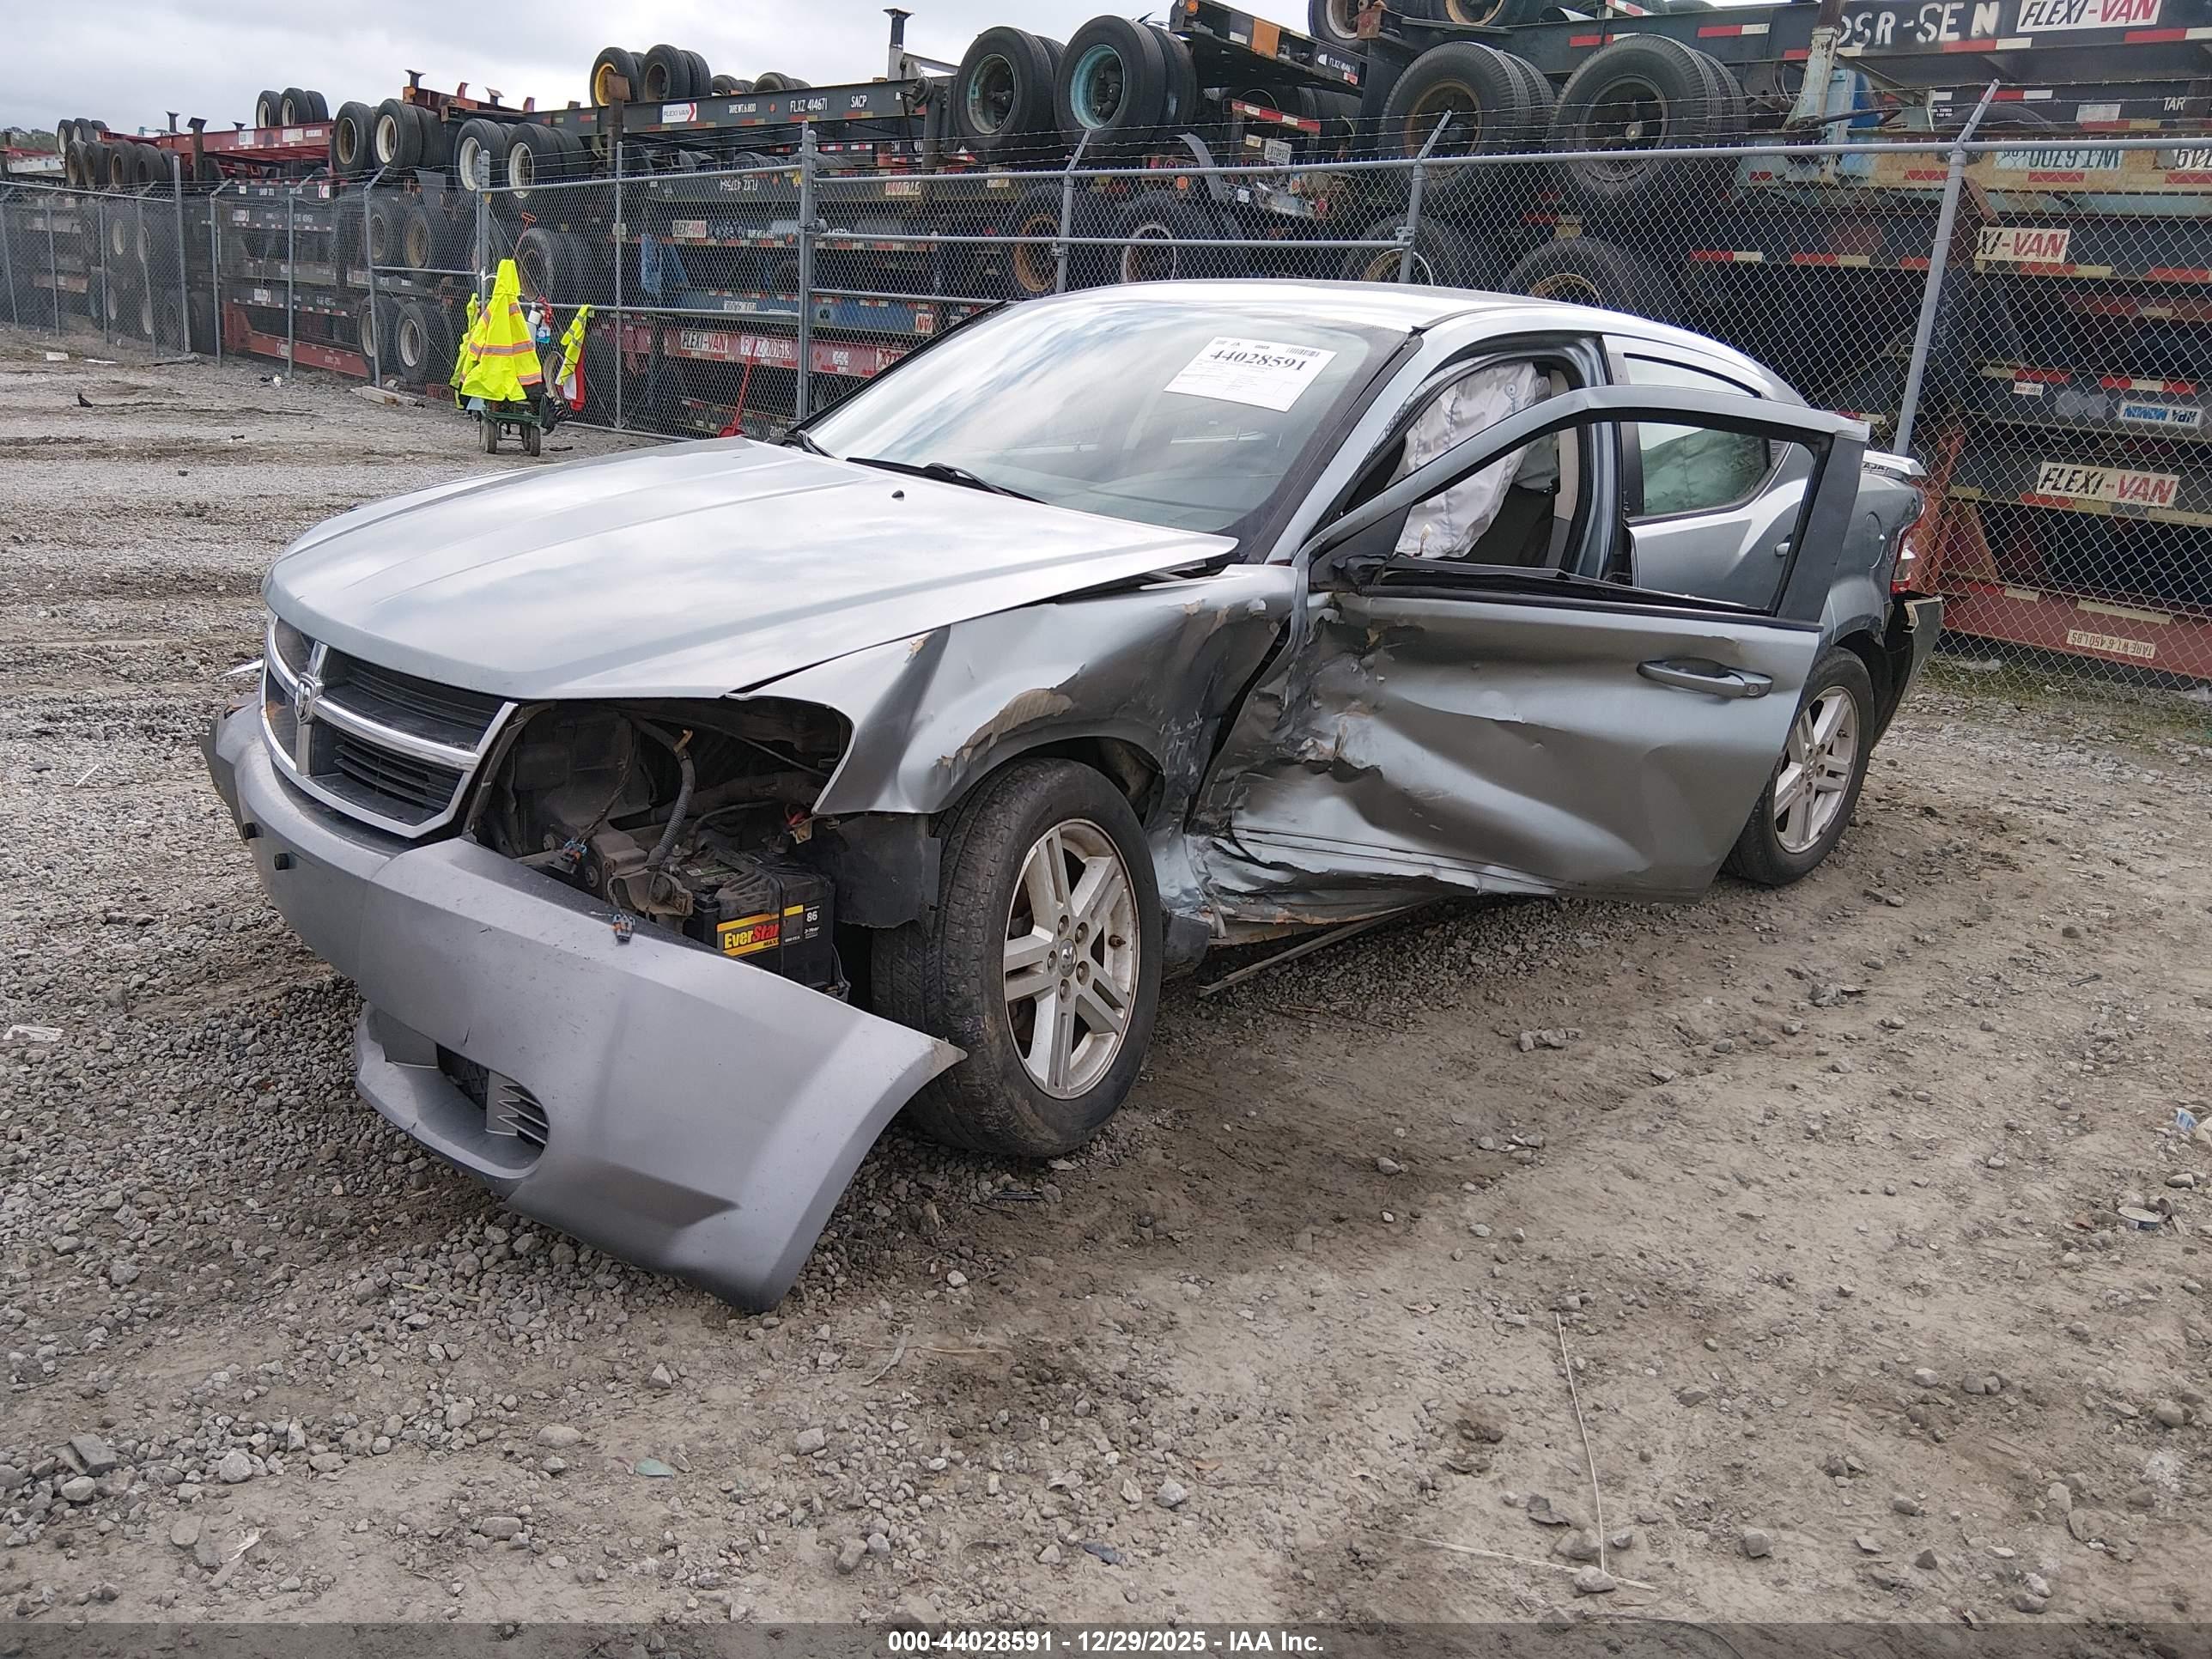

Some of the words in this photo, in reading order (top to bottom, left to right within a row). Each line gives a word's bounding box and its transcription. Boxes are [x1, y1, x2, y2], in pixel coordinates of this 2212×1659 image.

[2021, 0, 2158, 27] FLEXI-VAN
[790, 100, 805, 112] FLXZ
[807, 97, 827, 111] 414671
[851, 95, 867, 108] SACP
[682, 331, 726, 351] FLEXI-VAN
[1210, 349, 1307, 371] 44028591
[2039, 467, 2175, 503] FLEXI-VAN
[2130, 642, 2152, 656] TARE
[806, 911, 818, 922] 86
